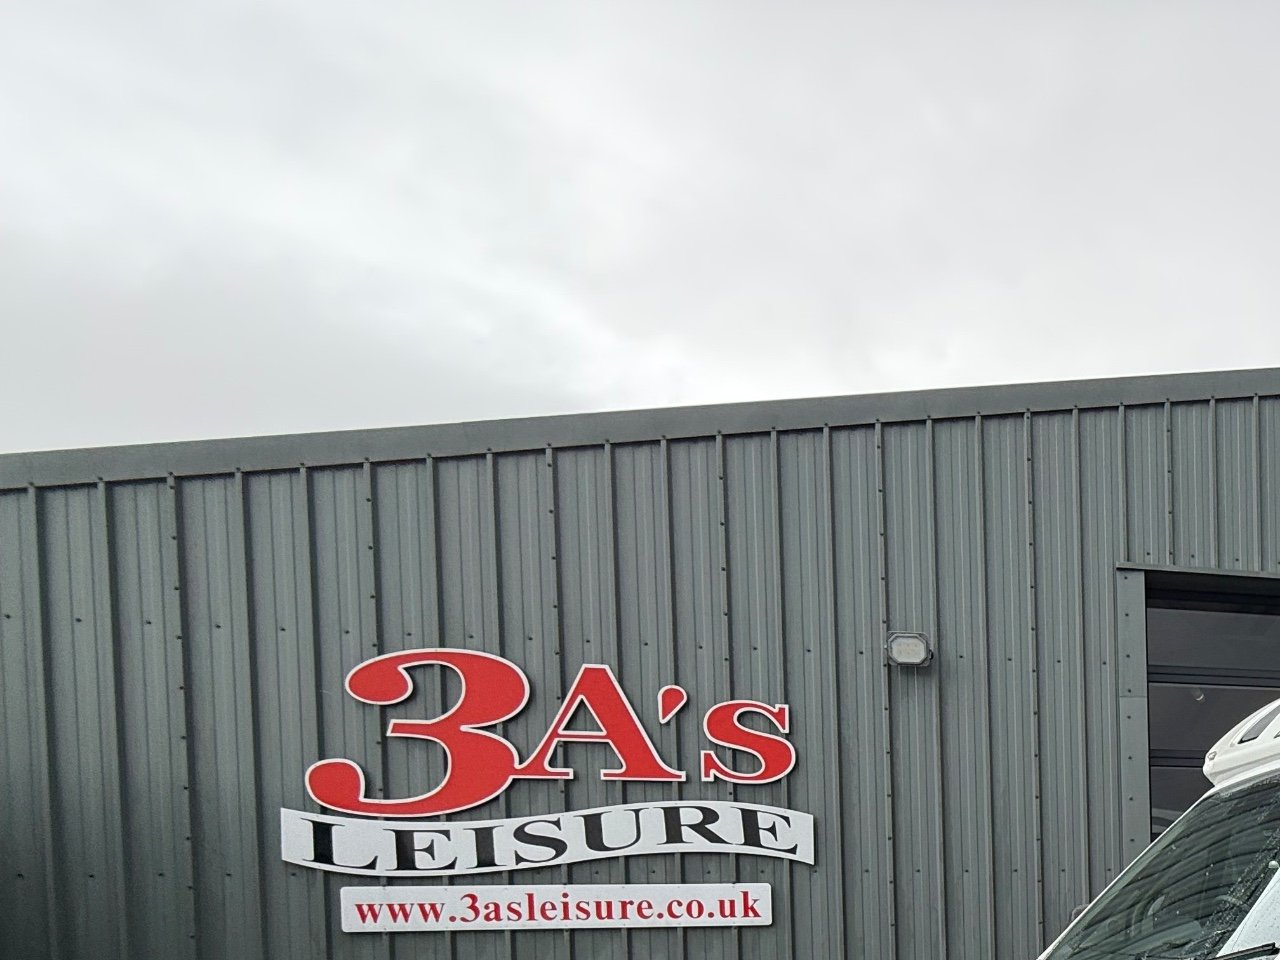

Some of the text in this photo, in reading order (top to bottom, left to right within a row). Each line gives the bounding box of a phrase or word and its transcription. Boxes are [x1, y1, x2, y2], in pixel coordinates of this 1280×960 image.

[305, 648, 796, 817] 3A's
[299, 805, 798, 871] LEISURE
[355, 889, 762, 924] www.3asleisure.co.uk
